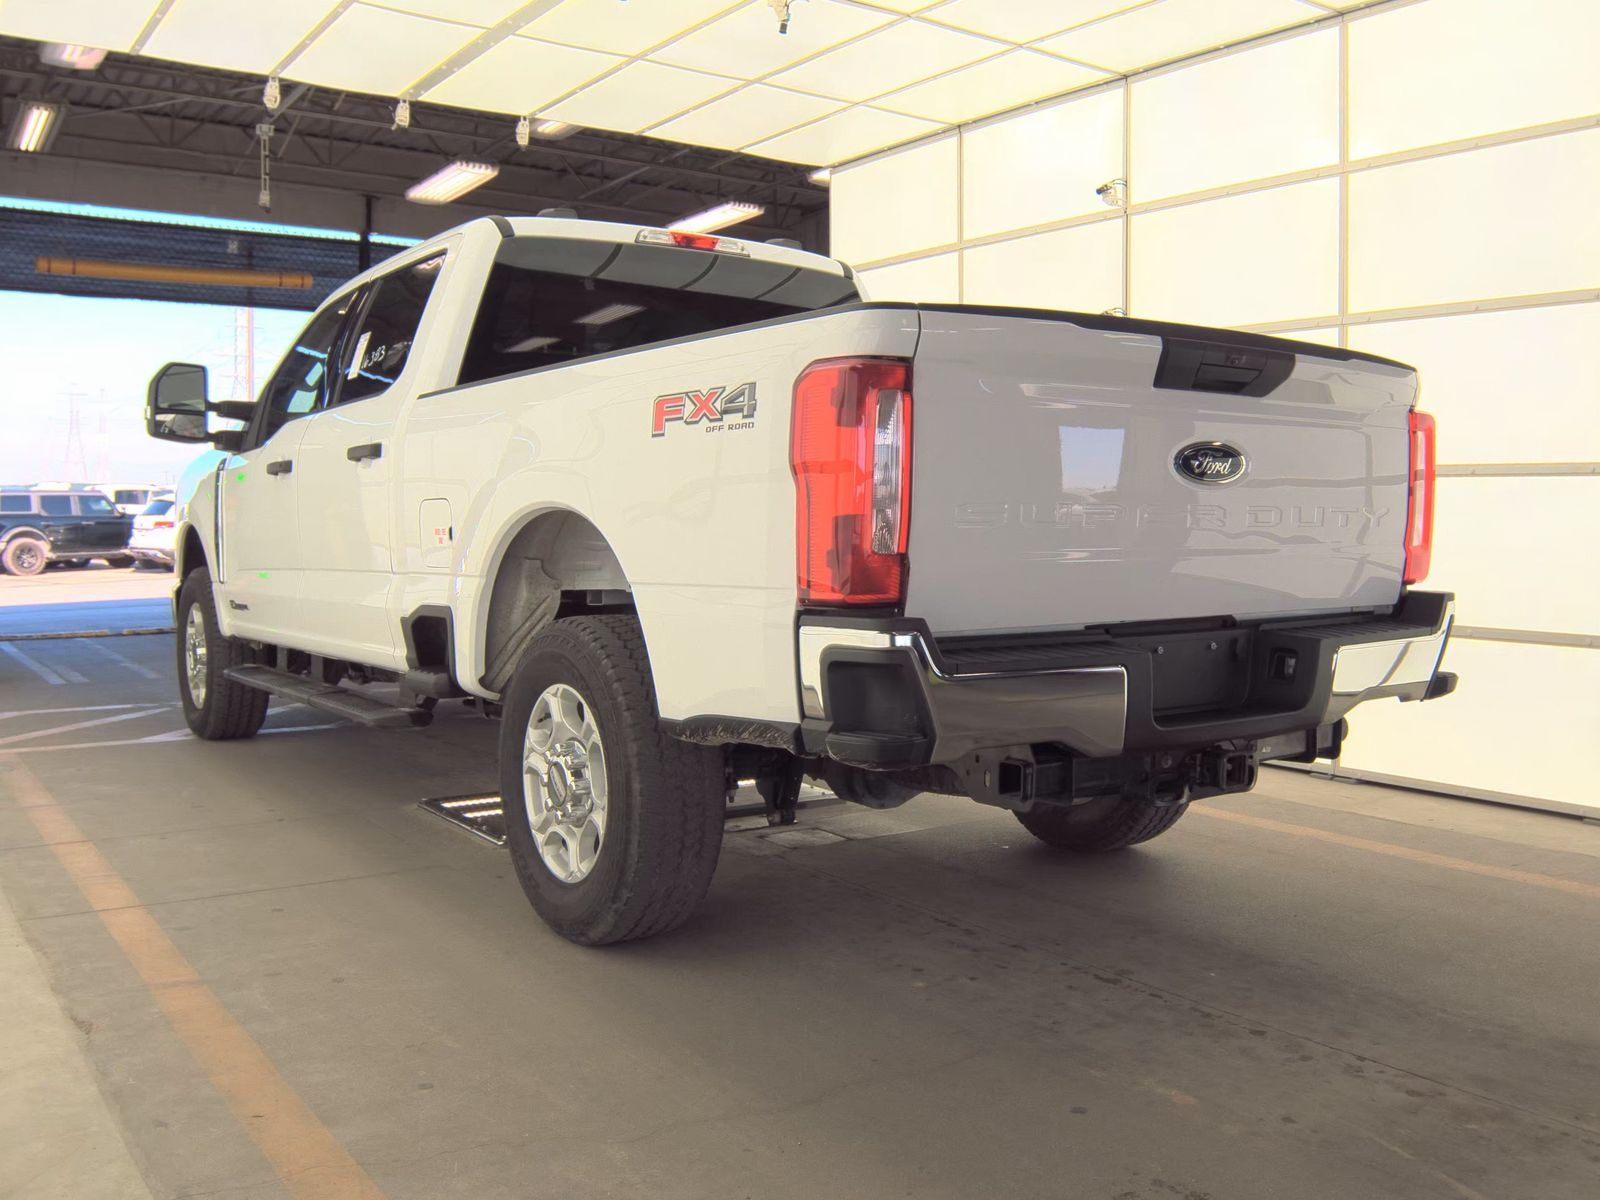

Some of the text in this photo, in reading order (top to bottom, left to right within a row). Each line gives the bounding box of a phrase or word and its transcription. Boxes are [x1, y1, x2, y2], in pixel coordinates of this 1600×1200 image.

[652, 381, 757, 438] FX4
[705, 421, 755, 433] OFF ROAD
[1190, 449, 1232, 475] Ford
[954, 502, 1391, 529] SUPER DUTY
